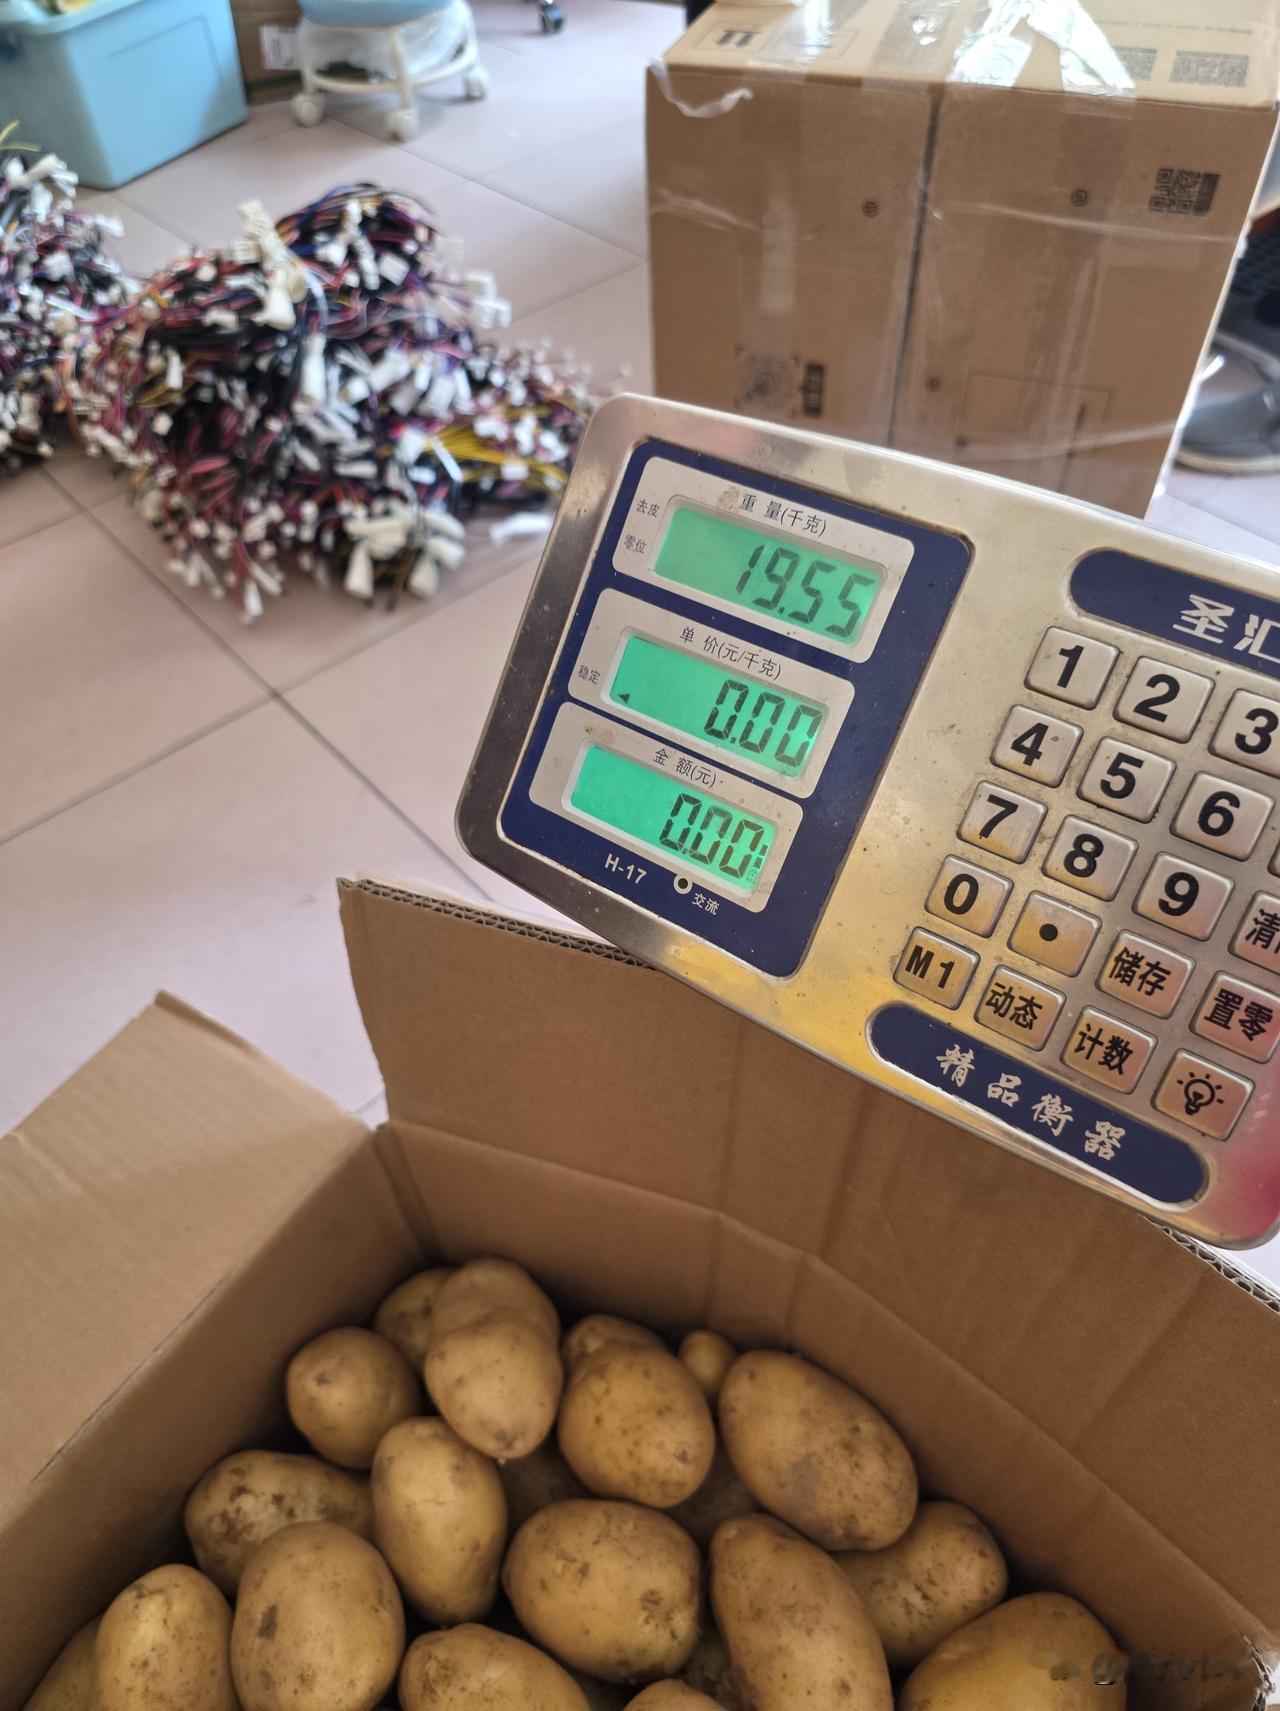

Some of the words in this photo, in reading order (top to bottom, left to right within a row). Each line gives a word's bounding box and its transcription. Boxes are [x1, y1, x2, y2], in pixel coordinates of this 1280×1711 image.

[635, 499, 660, 519] 去皮
[624, 535, 648, 555] 零位
[735, 544, 875, 638] 19.55
[578, 664, 601, 685] 稳定
[1056, 645, 1085, 689] 1
[1132, 673, 1181, 723] 2
[703, 679, 823, 767] 0.00
[1009, 722, 1048, 766] 4
[1235, 708, 1279, 755] 3
[1099, 754, 1144, 799] 5
[659, 793, 765, 879] 0.00
[979, 793, 1019, 839] 7
[1198, 790, 1240, 837] 6
[604, 853, 647, 885] H-17
[1062, 832, 1104, 878] 8
[691, 892, 721, 916] 交流
[943, 873, 979, 916] 0
[1158, 871, 1200, 917] 9
[1244, 908, 1280, 955] 清
[1108, 947, 1171, 997] 储存
[984, 981, 1043, 1031] 动态
[1205, 987, 1273, 1042] 置零
[1073, 1023, 1133, 1076] 计数
[936, 1043, 1126, 1161] 精品衡器
